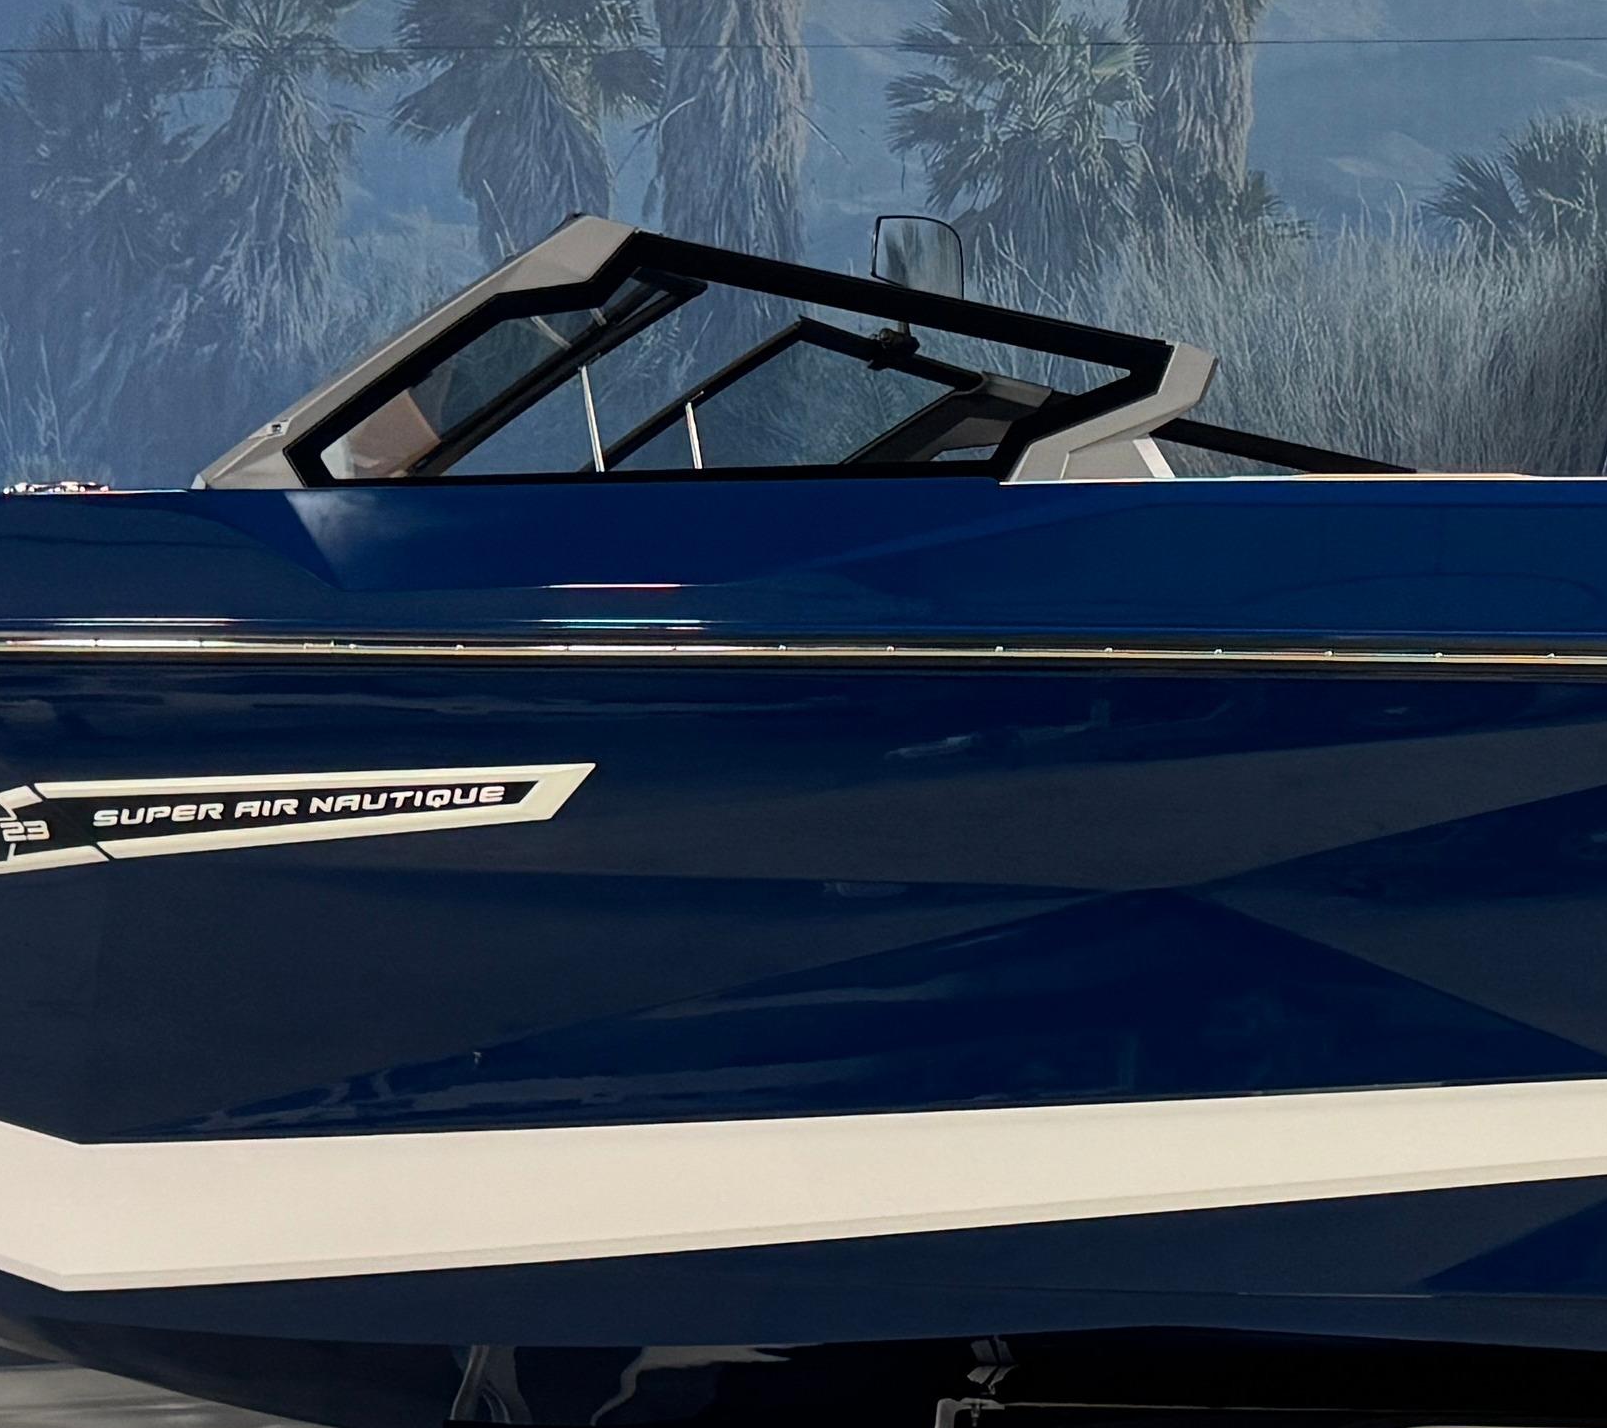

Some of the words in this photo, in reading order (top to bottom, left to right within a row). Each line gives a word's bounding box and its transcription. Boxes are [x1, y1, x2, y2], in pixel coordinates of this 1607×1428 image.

[92, 802, 225, 827] SUPER
[234, 798, 300, 819] AIR
[309, 784, 506, 814] NAUTIQUE
